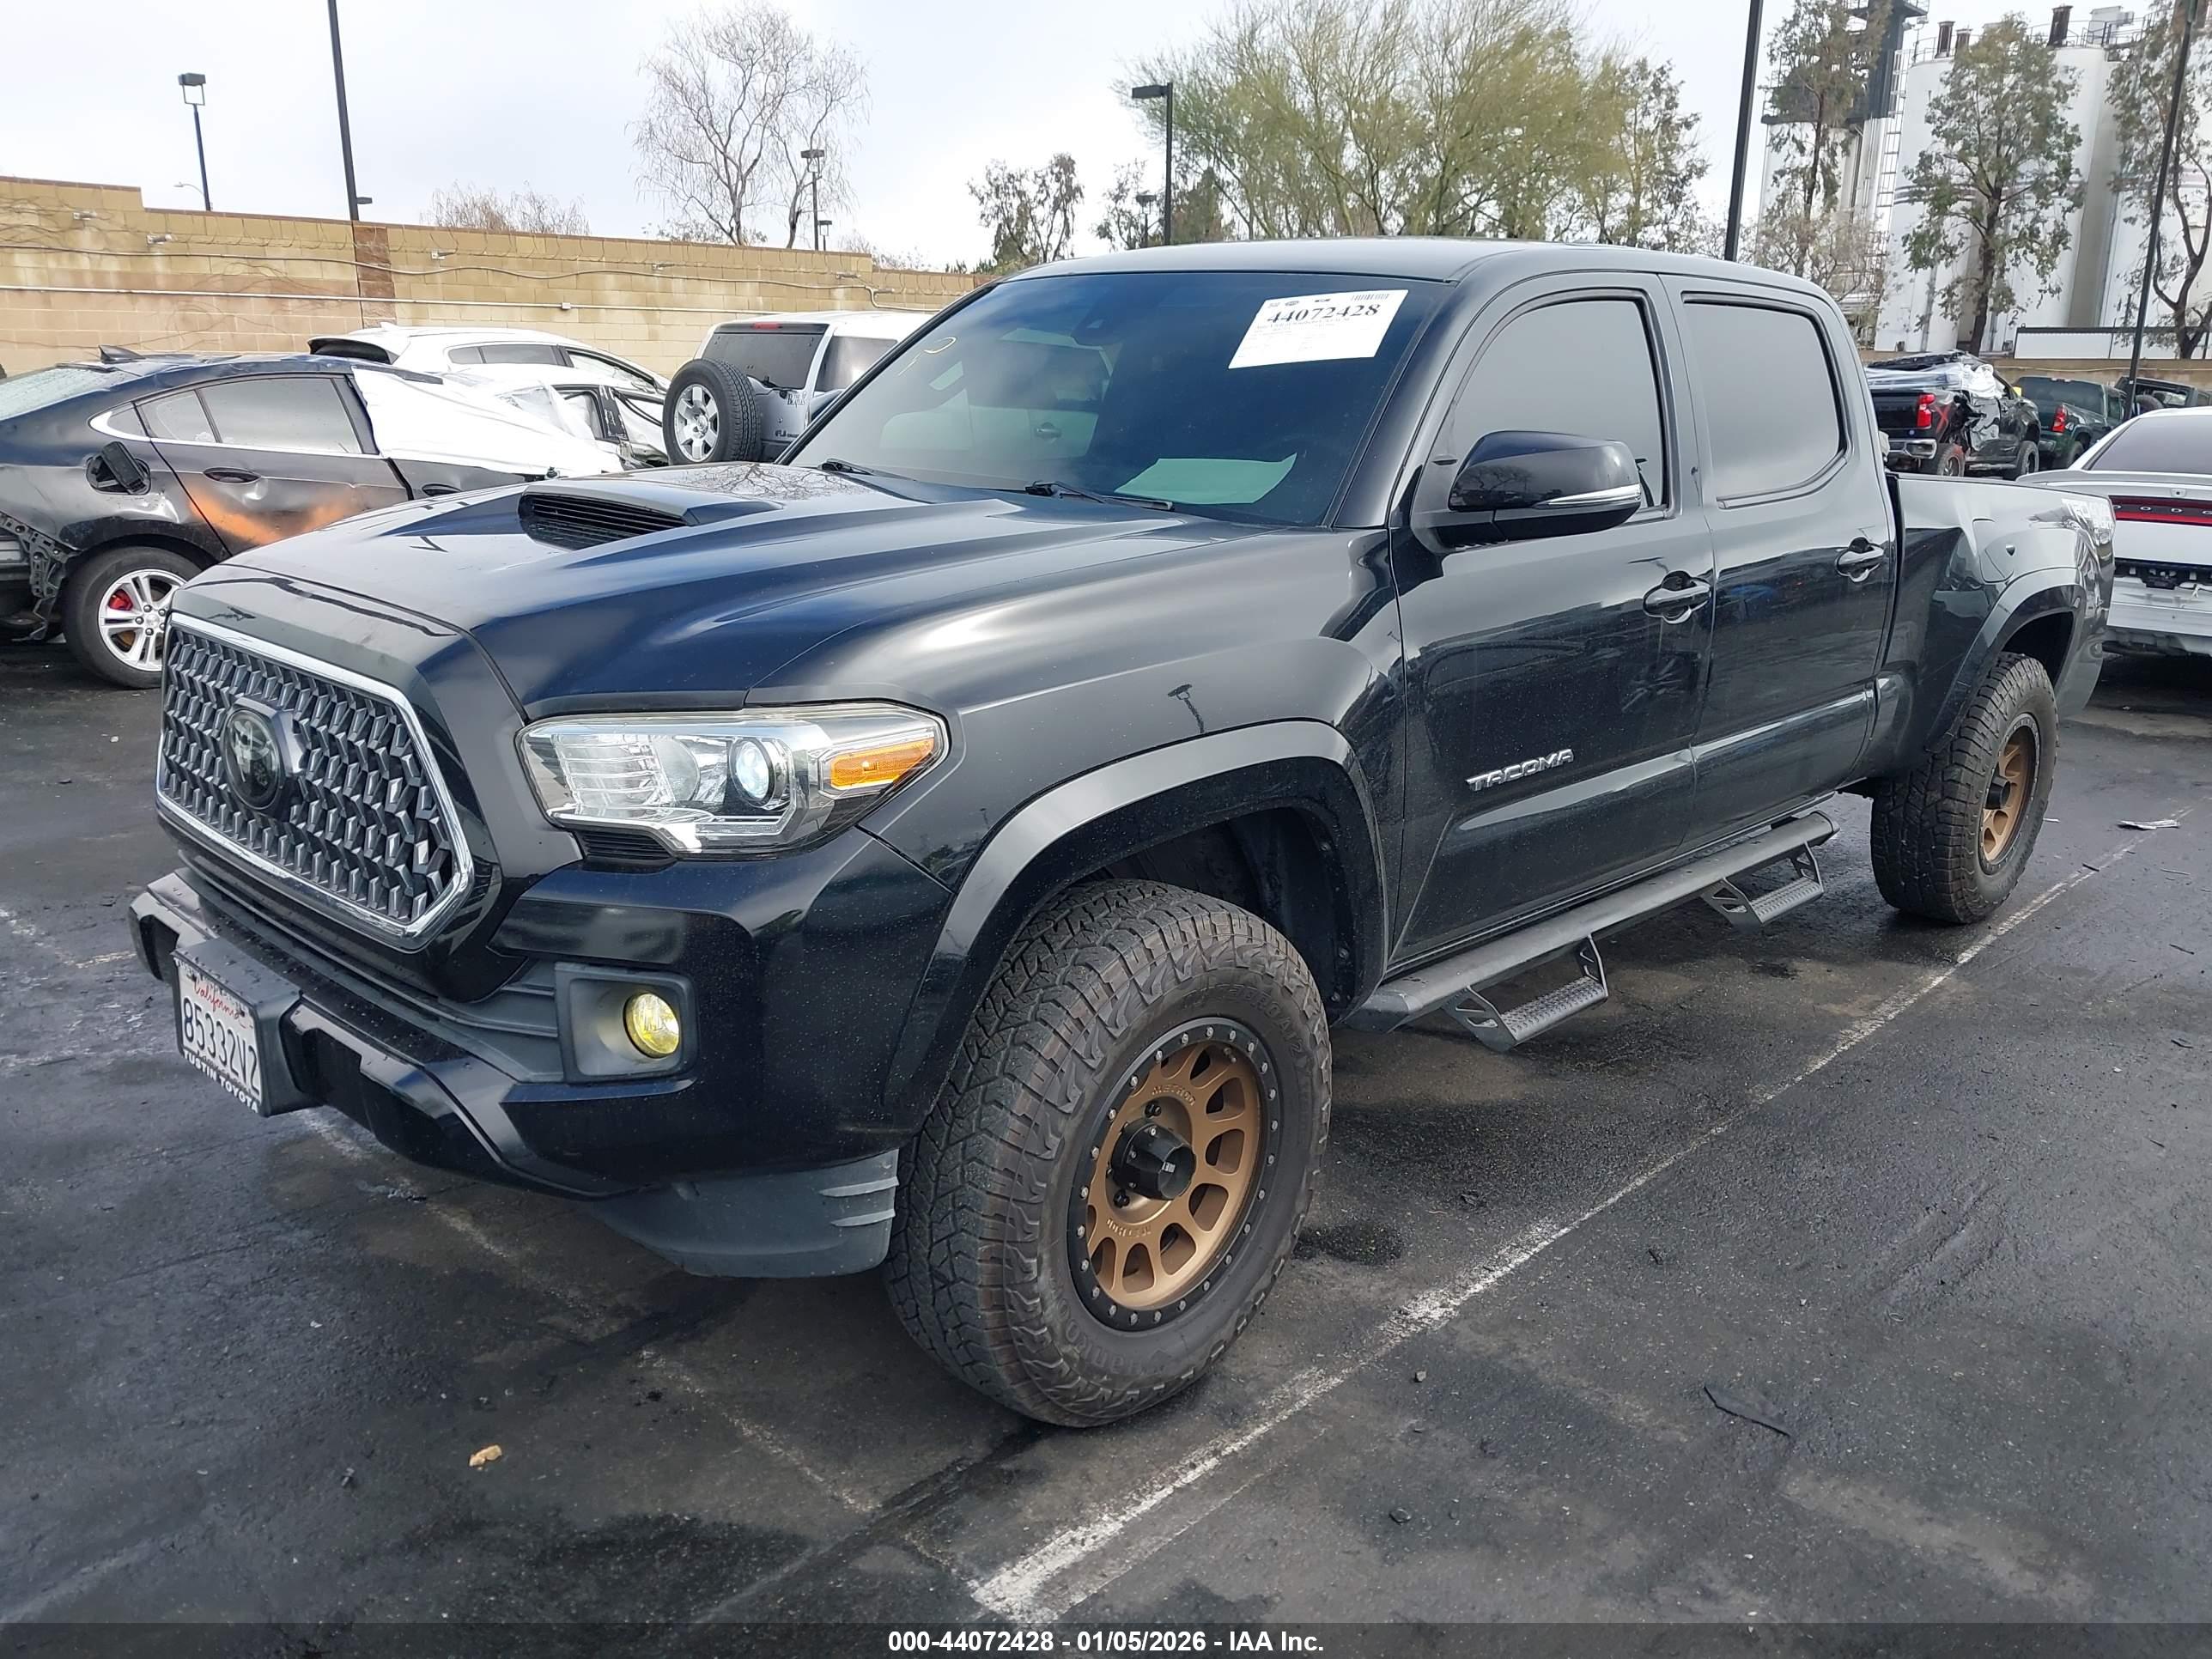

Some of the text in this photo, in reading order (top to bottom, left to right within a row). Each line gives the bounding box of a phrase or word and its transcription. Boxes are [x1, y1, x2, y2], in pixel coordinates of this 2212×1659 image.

[1267, 304, 1380, 323] 44072428
[2012, 310, 2019, 319] 2
[1465, 749, 1574, 792] TACOMA
[183, 997, 260, 1096] 85332V2
[184, 1049, 216, 1081] TUSTIN
[219, 1075, 258, 1114] TOYOTA
